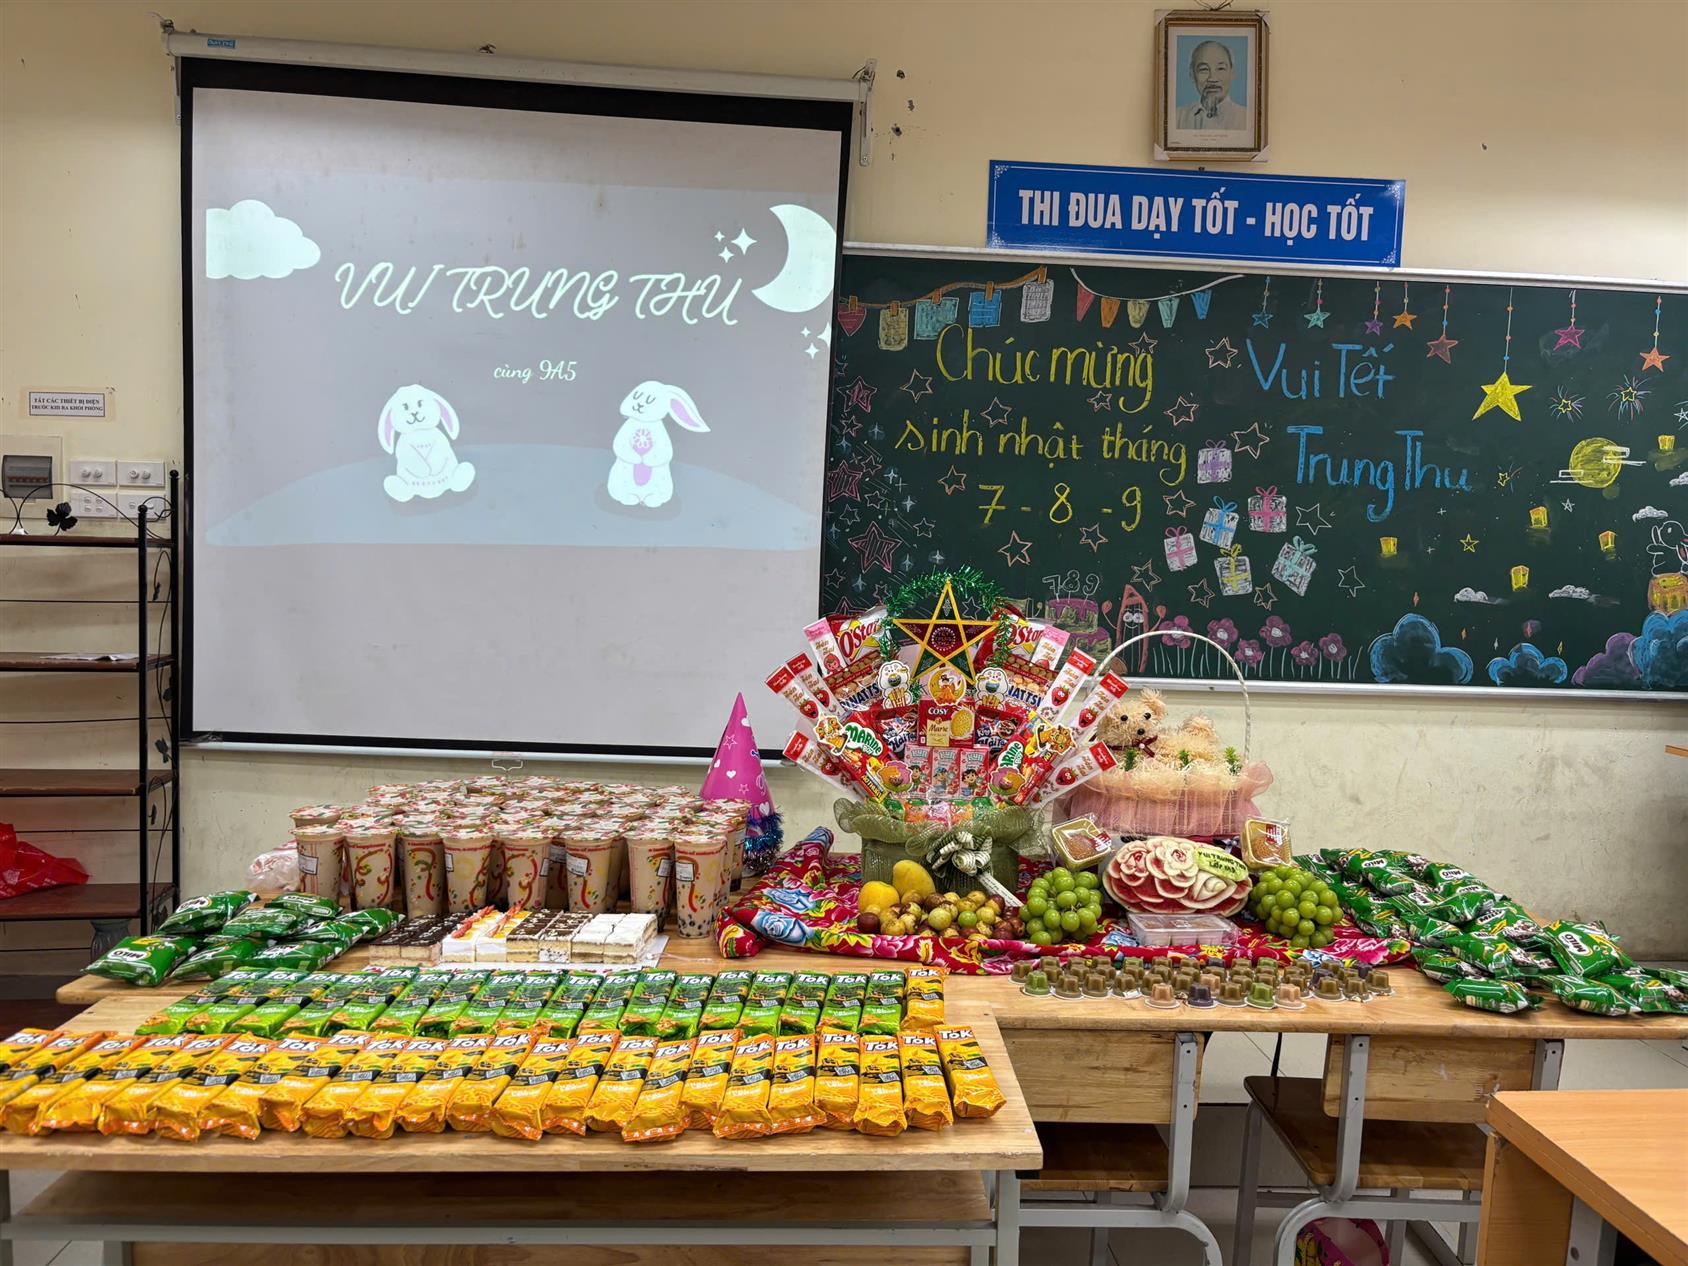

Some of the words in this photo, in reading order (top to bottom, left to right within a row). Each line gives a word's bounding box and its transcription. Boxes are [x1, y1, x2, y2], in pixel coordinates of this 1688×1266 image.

[1018, 188, 1060, 227] THI
[1068, 191, 1123, 230] ĐUA
[1131, 196, 1184, 240] DẠY
[1192, 187, 1239, 236] TỐT
[1264, 202, 1318, 246] HỌC
[1326, 193, 1374, 242] TỐT
[334, 262, 445, 315] VUI
[445, 265, 619, 321] TRUNG
[628, 271, 743, 326] THU
[493, 364, 532, 384] cùng
[538, 359, 578, 382] 9A5
[936, 324, 1040, 385] Chúc
[1050, 341, 1153, 414] mừng
[1246, 339, 1320, 400] Vui
[1331, 343, 1397, 400] Tết
[895, 409, 984, 455] sinh
[998, 416, 1084, 470] nhật
[1101, 421, 1187, 486] tháng
[1286, 425, 1396, 522] Trung
[1394, 429, 1473, 491] Thu
[978, 484, 1007, 524] 7
[1049, 482, 1074, 524] 8
[1120, 486, 1142, 532] 9
[927, 706, 949, 715] COSY
[112, 949, 146, 959] MILO
[1564, 933, 1587, 954] MILO
